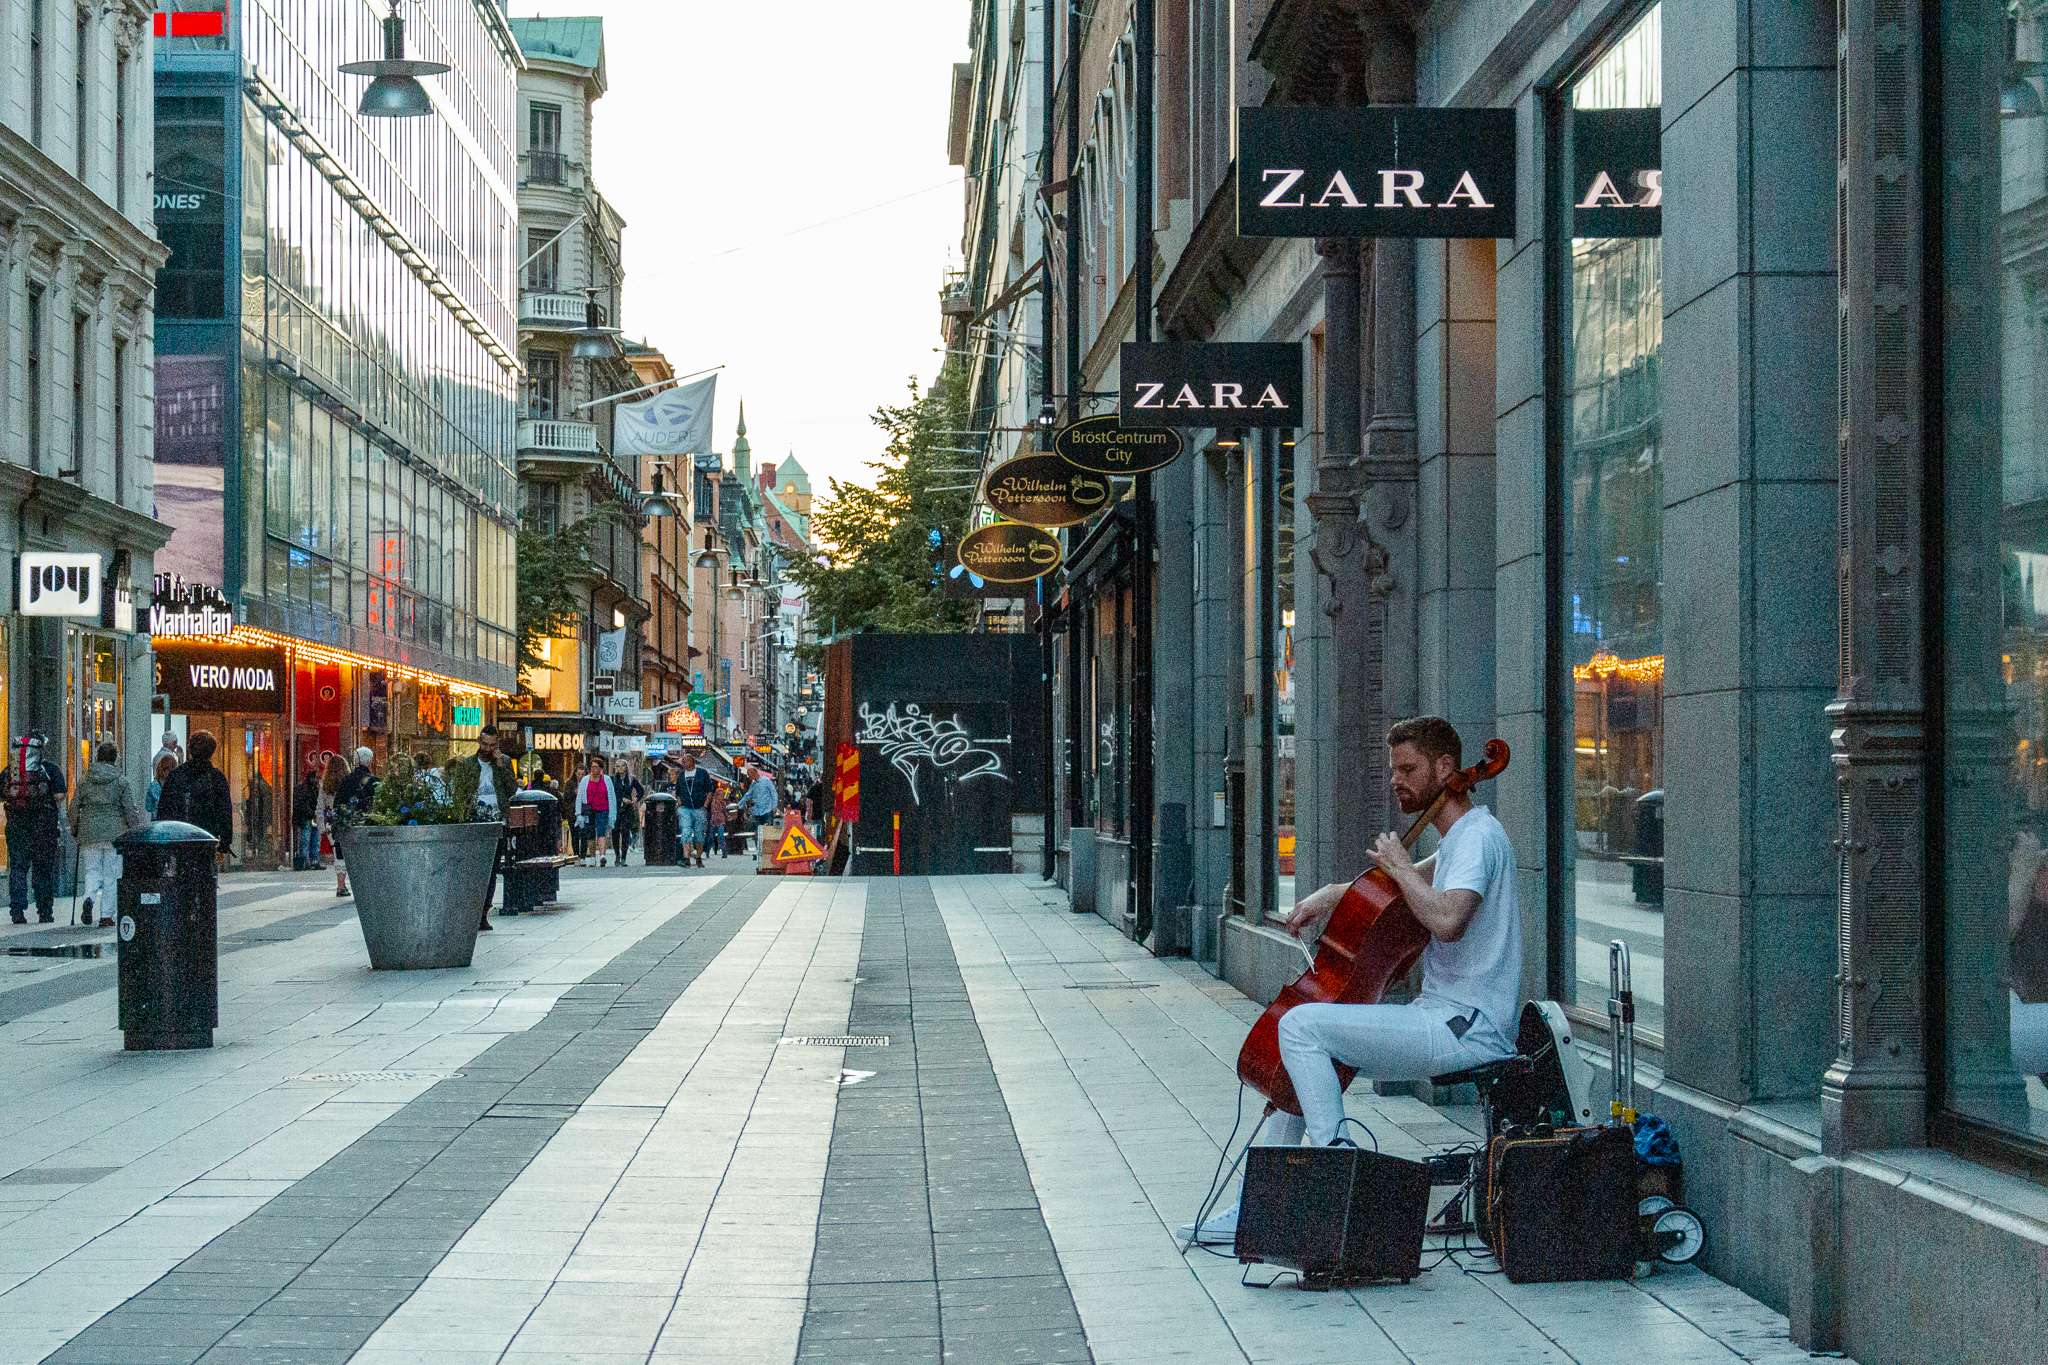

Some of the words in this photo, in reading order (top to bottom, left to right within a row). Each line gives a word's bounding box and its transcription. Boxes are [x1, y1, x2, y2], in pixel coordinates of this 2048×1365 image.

[1259, 169, 1495, 208] ZARA
[1133, 382, 1289, 408] ZARA
[631, 429, 698, 443] AUDERE
[1105, 448, 1133, 464] City
[1002, 477, 1067, 492] Wilhelm
[973, 543, 1025, 554] Wilhelm
[150, 604, 232, 635] Manhattan
[189, 664, 230, 689] VERO
[232, 667, 275, 691] MODA
[608, 697, 635, 708] FACE
